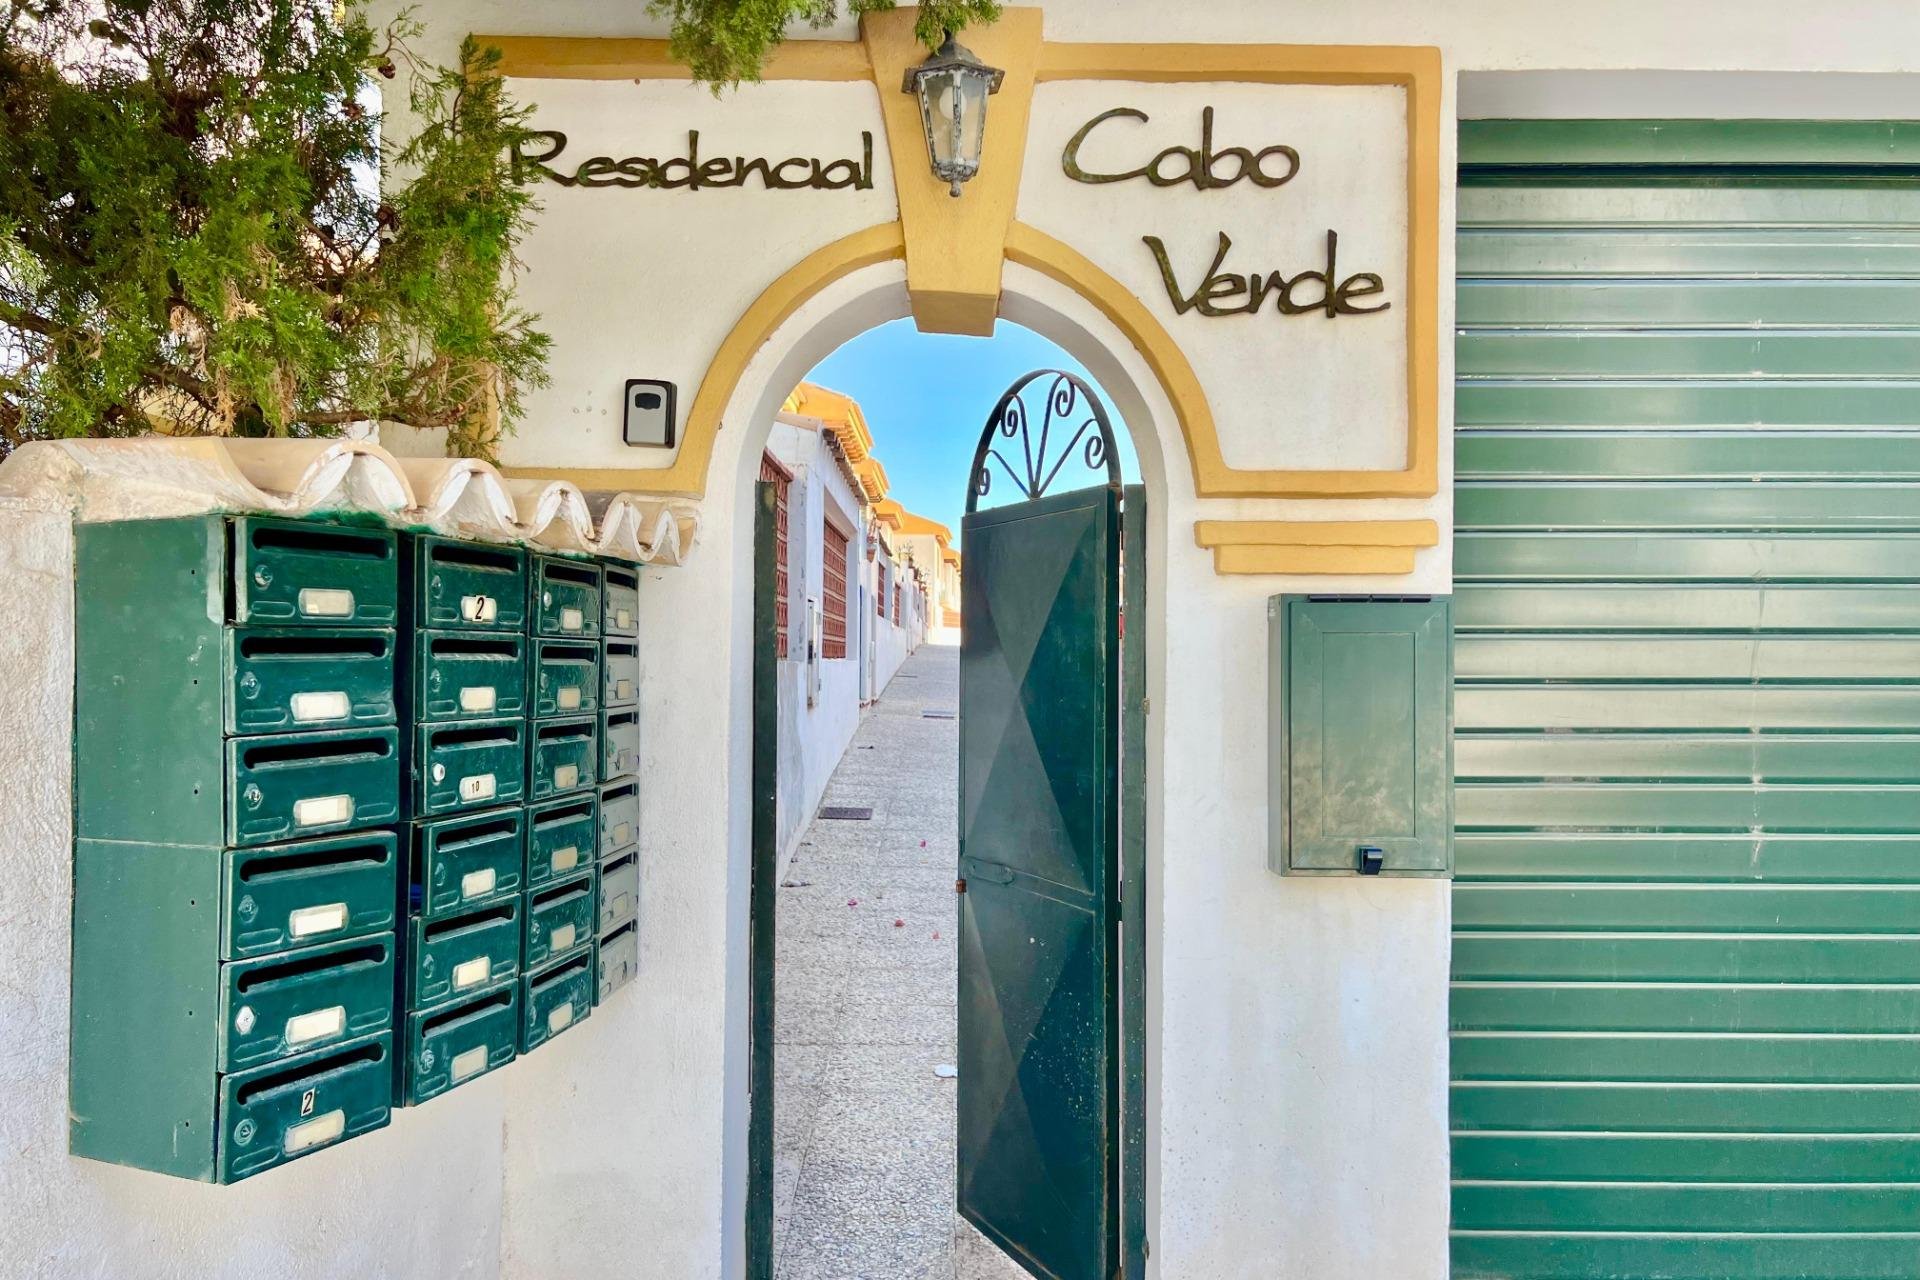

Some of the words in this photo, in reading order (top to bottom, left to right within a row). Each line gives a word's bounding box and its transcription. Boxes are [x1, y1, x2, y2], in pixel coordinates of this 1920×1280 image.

[1062, 106, 1300, 191] Cabo
[1142, 229, 1391, 319] Verde
[475, 596, 485, 619] 2
[302, 1091, 313, 1115] 2
